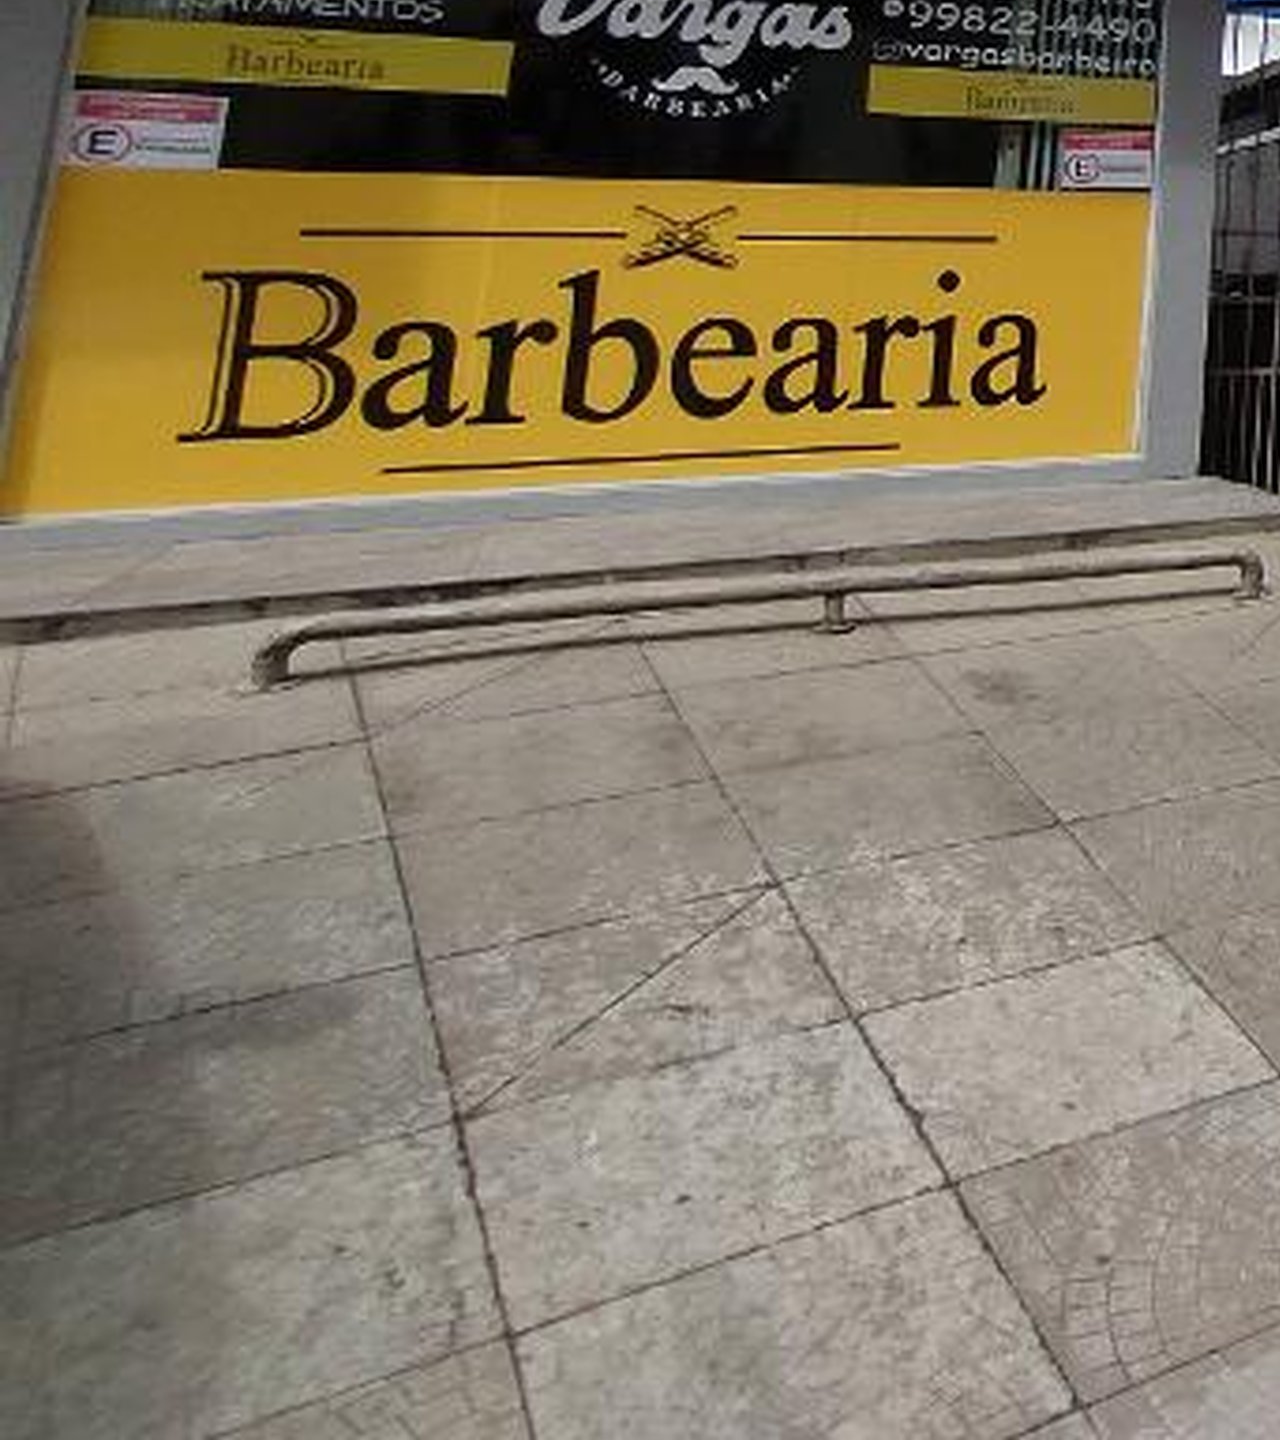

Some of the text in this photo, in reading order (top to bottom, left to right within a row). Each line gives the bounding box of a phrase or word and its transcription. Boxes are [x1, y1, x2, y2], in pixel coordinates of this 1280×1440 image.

[908, 0, 1157, 44] 99822-4490
[226, 45, 386, 81] Barbearia
[176, 268, 1046, 444] Barbearia
